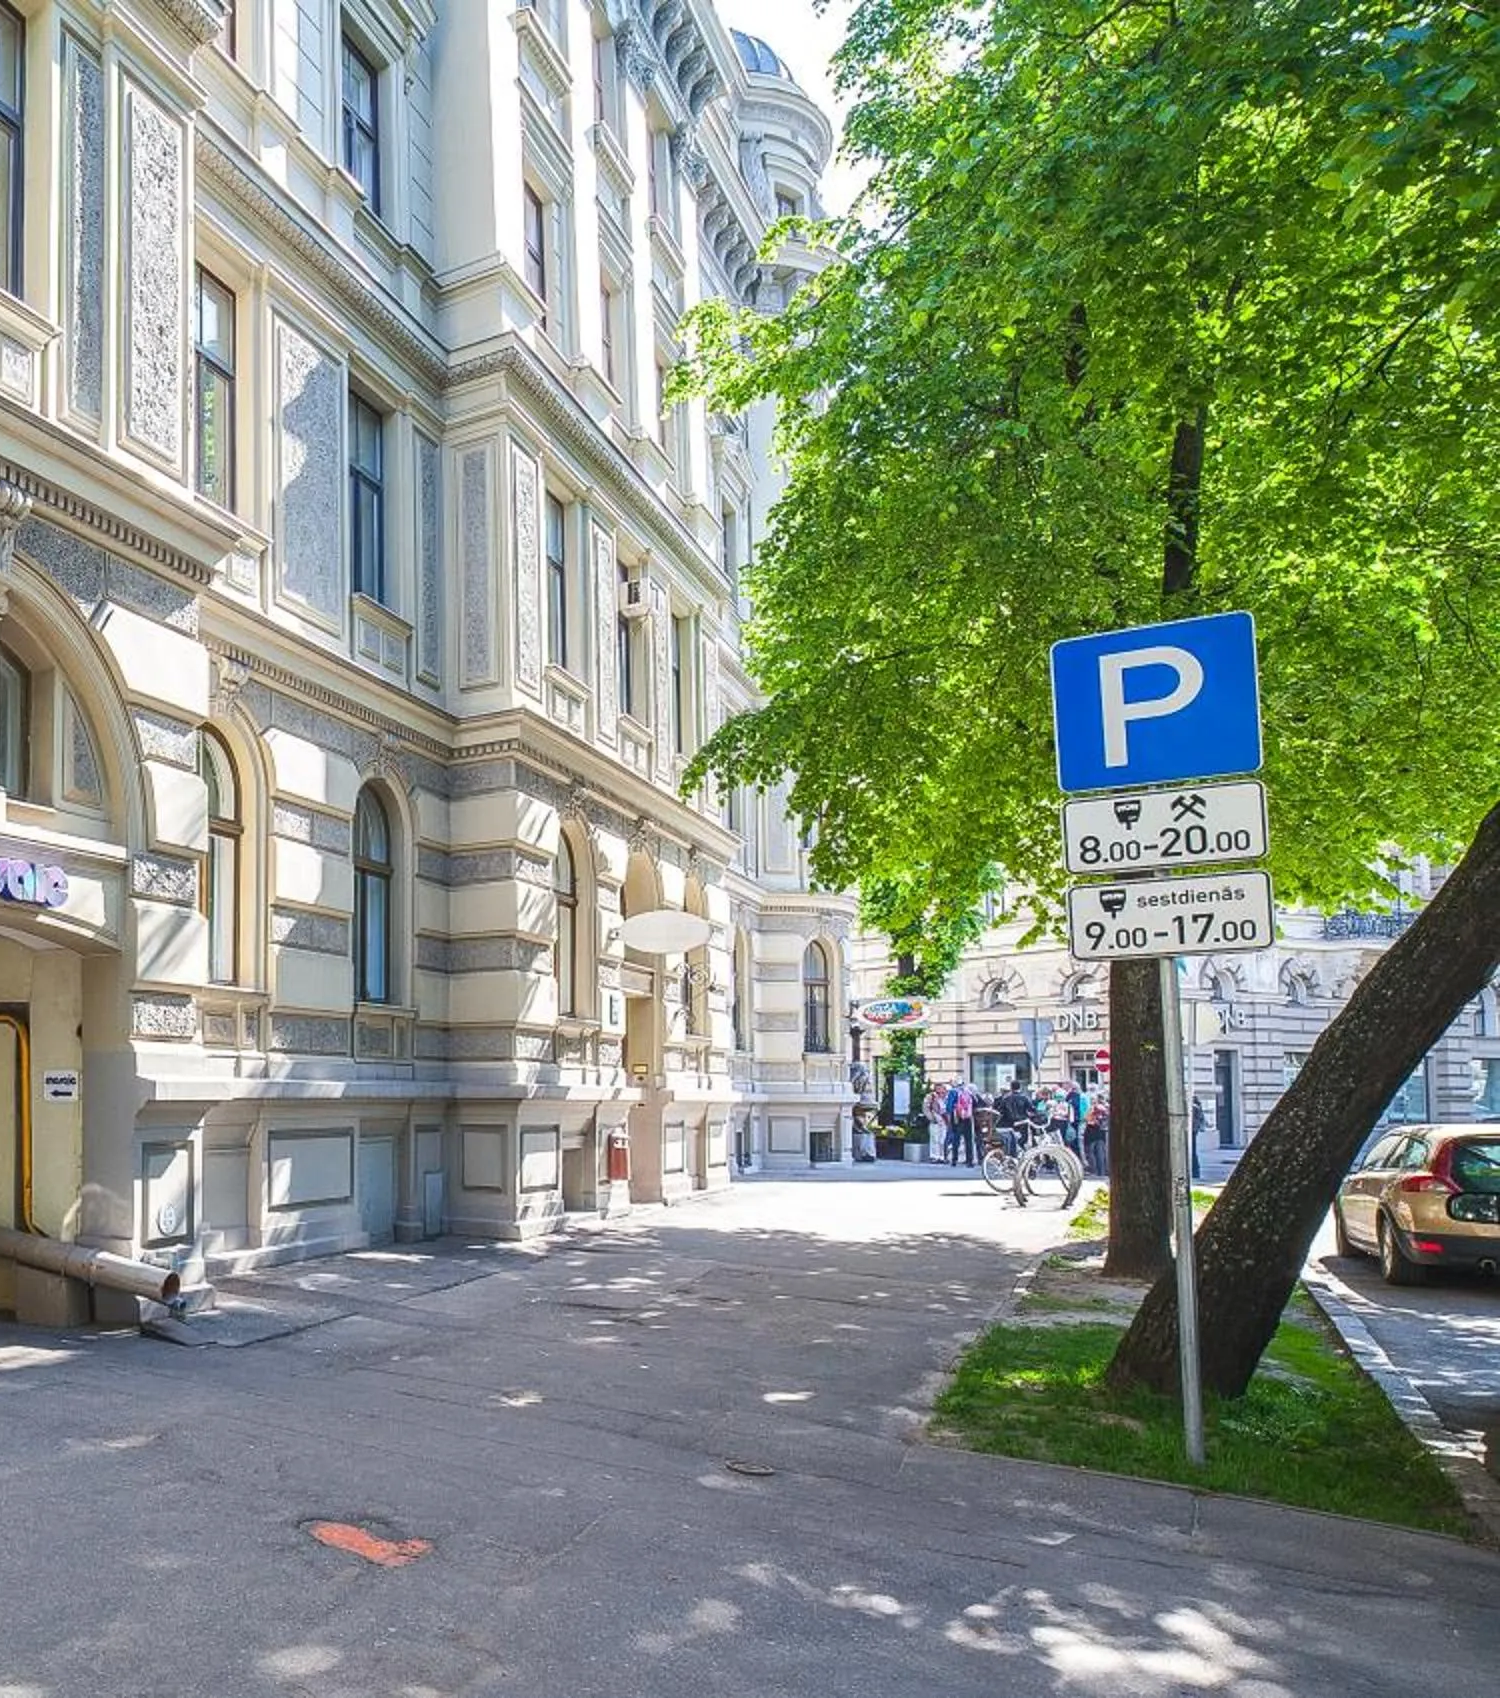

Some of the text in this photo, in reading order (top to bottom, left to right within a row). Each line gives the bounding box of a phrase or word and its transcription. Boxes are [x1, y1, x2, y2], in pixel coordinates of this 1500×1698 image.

[1099, 646, 1203, 768] P
[1079, 824, 1251, 865] 8.00-20.00
[1136, 886, 1245, 908] sestdienās
[1055, 1005, 1099, 1036] DNB
